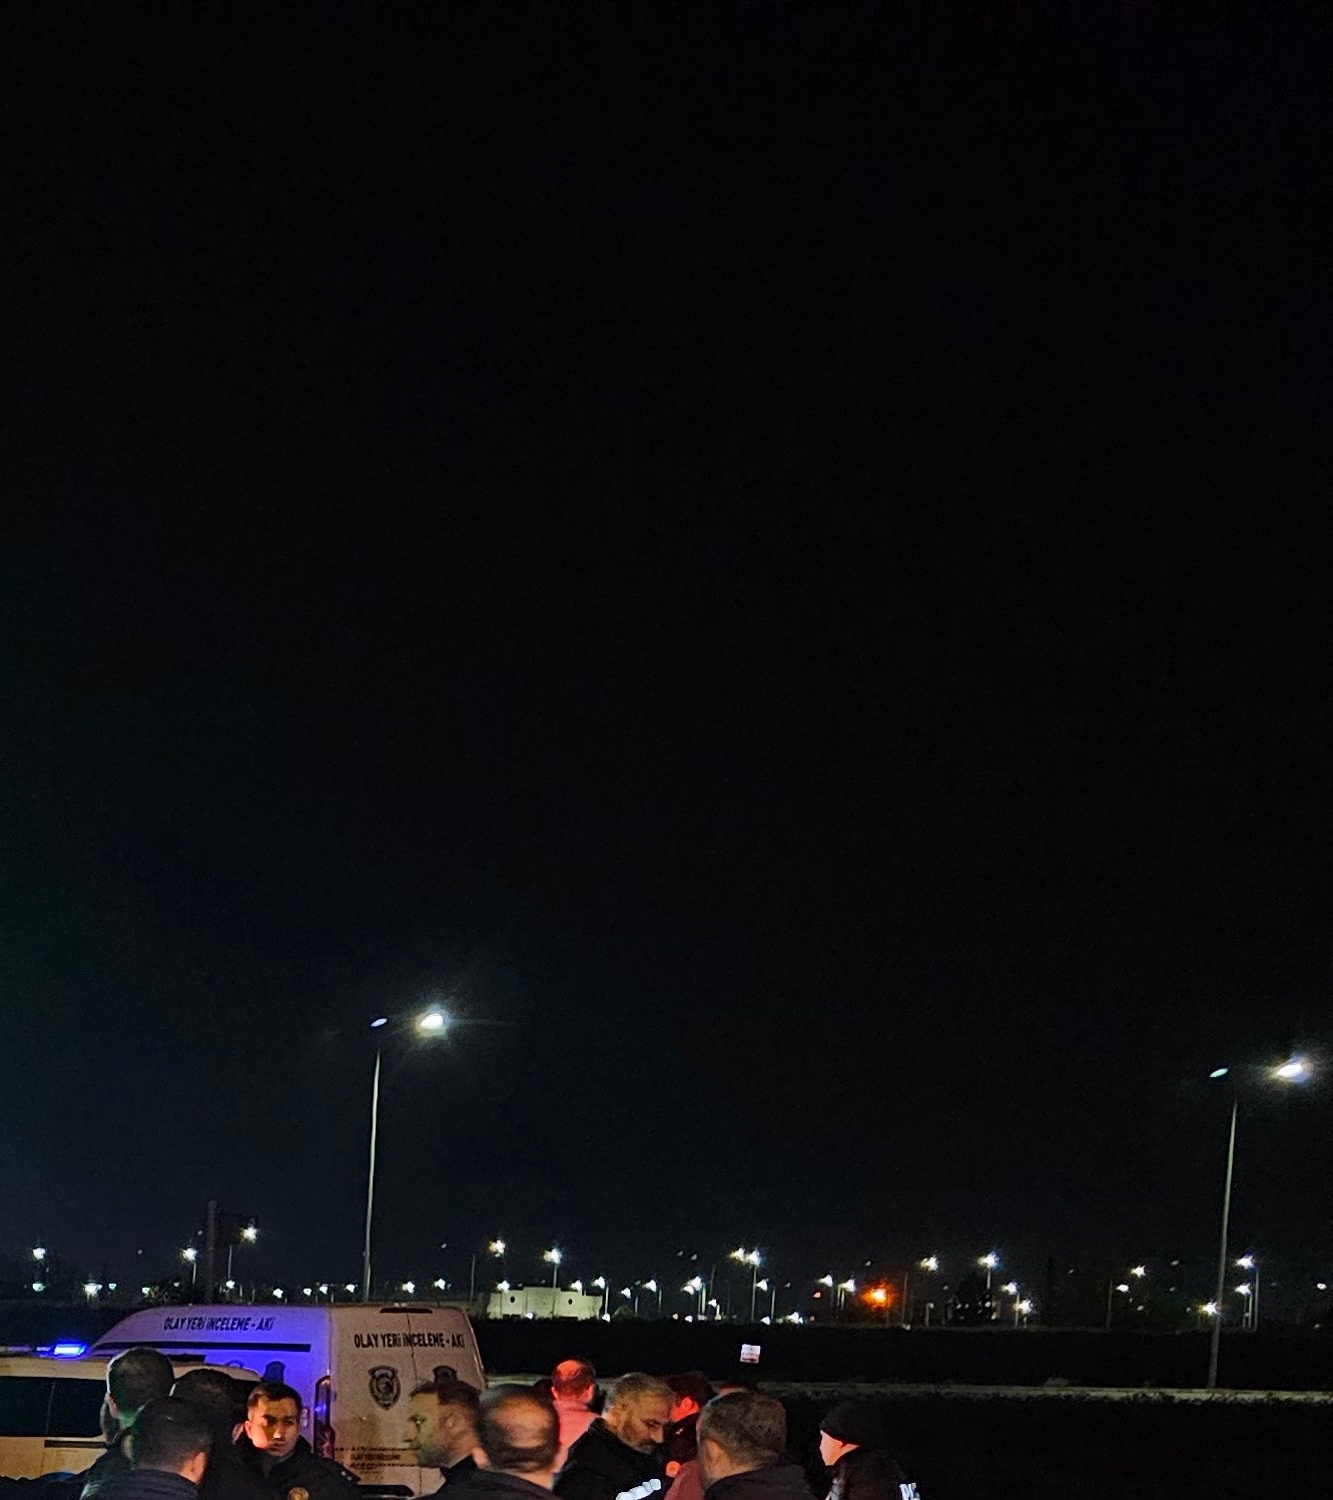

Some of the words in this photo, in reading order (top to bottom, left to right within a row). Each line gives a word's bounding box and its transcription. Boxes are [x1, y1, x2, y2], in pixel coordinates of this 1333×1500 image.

[354, 1333, 379, 1349] OLAY
[380, 1333, 402, 1348] YERİ
[402, 1332, 445, 1348] İNCELEME
